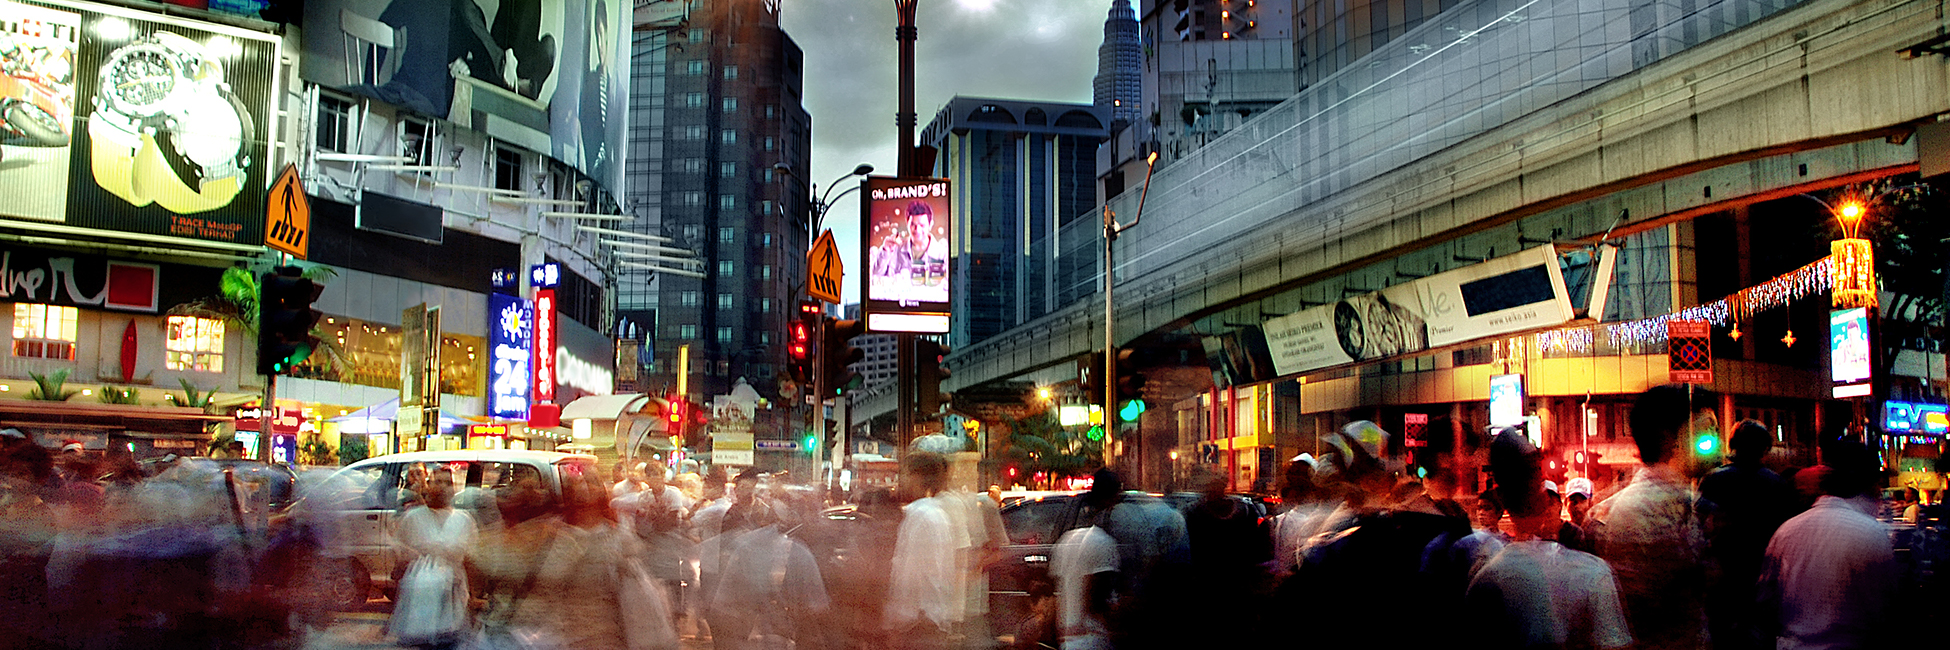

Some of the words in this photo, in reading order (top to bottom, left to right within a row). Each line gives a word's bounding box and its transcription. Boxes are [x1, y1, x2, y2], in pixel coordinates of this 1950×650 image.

[872, 189, 886, 200] Oh,
[887, 182, 947, 199] BRAND'S!
[494, 358, 527, 396] 24
